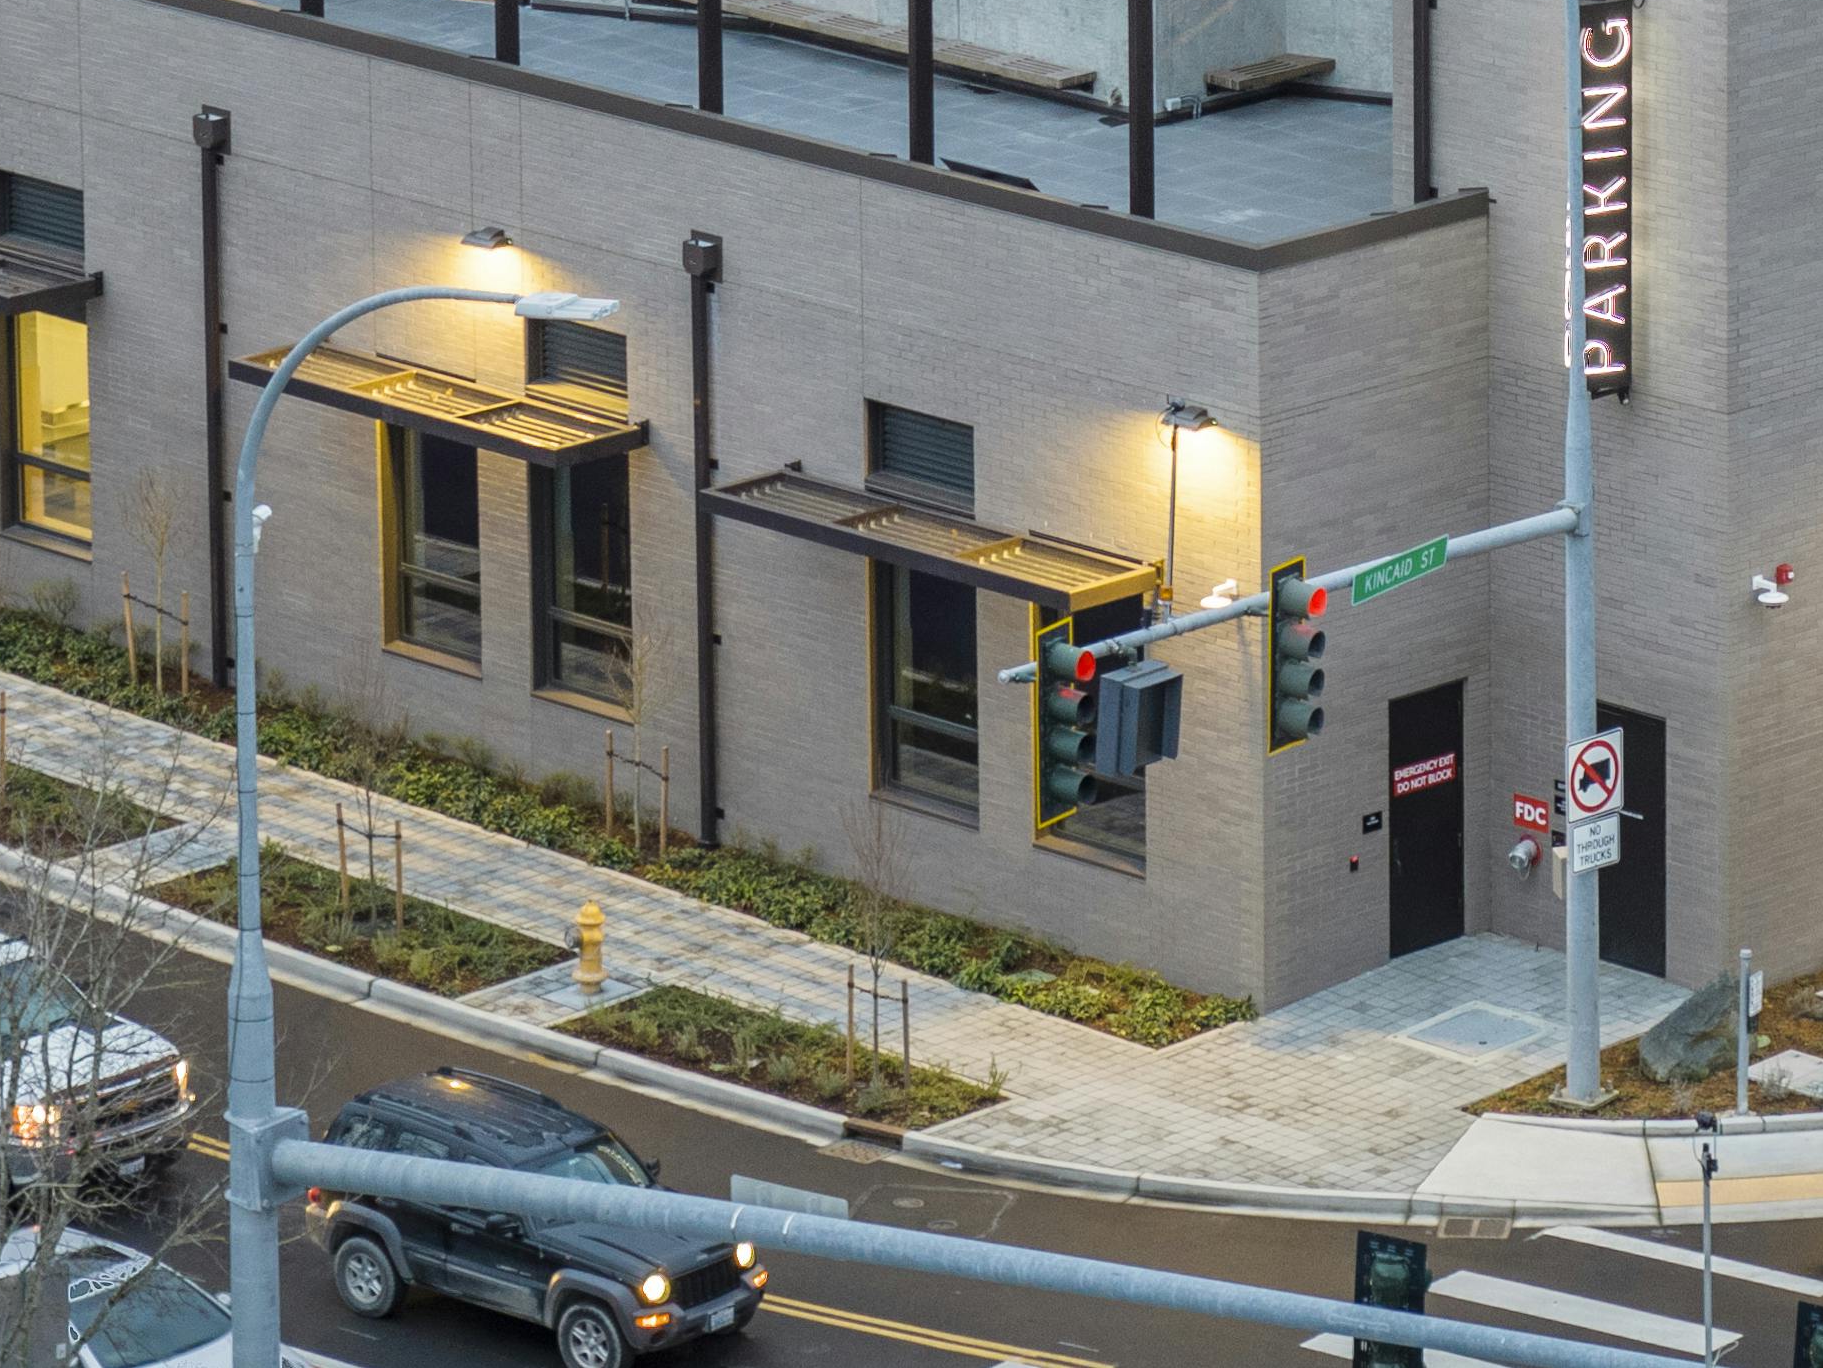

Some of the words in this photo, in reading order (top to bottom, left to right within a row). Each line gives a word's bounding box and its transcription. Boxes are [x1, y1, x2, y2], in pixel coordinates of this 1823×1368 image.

[1580, 17, 1631, 375] PARKING
[1364, 557, 1413, 594] KINCAID
[1420, 547, 1436, 569] ST
[1394, 758, 1437, 781] EMERGENCY
[1438, 752, 1456, 768] EXIT
[1397, 780, 1410, 794] DO
[1410, 775, 1427, 790] NOT
[1427, 767, 1453, 785] BLOCK
[1515, 800, 1547, 826] FDC
[1589, 824, 1602, 837] NO
[1577, 834, 1615, 855] THROUGH
[1580, 848, 1612, 866] TRUCKS
